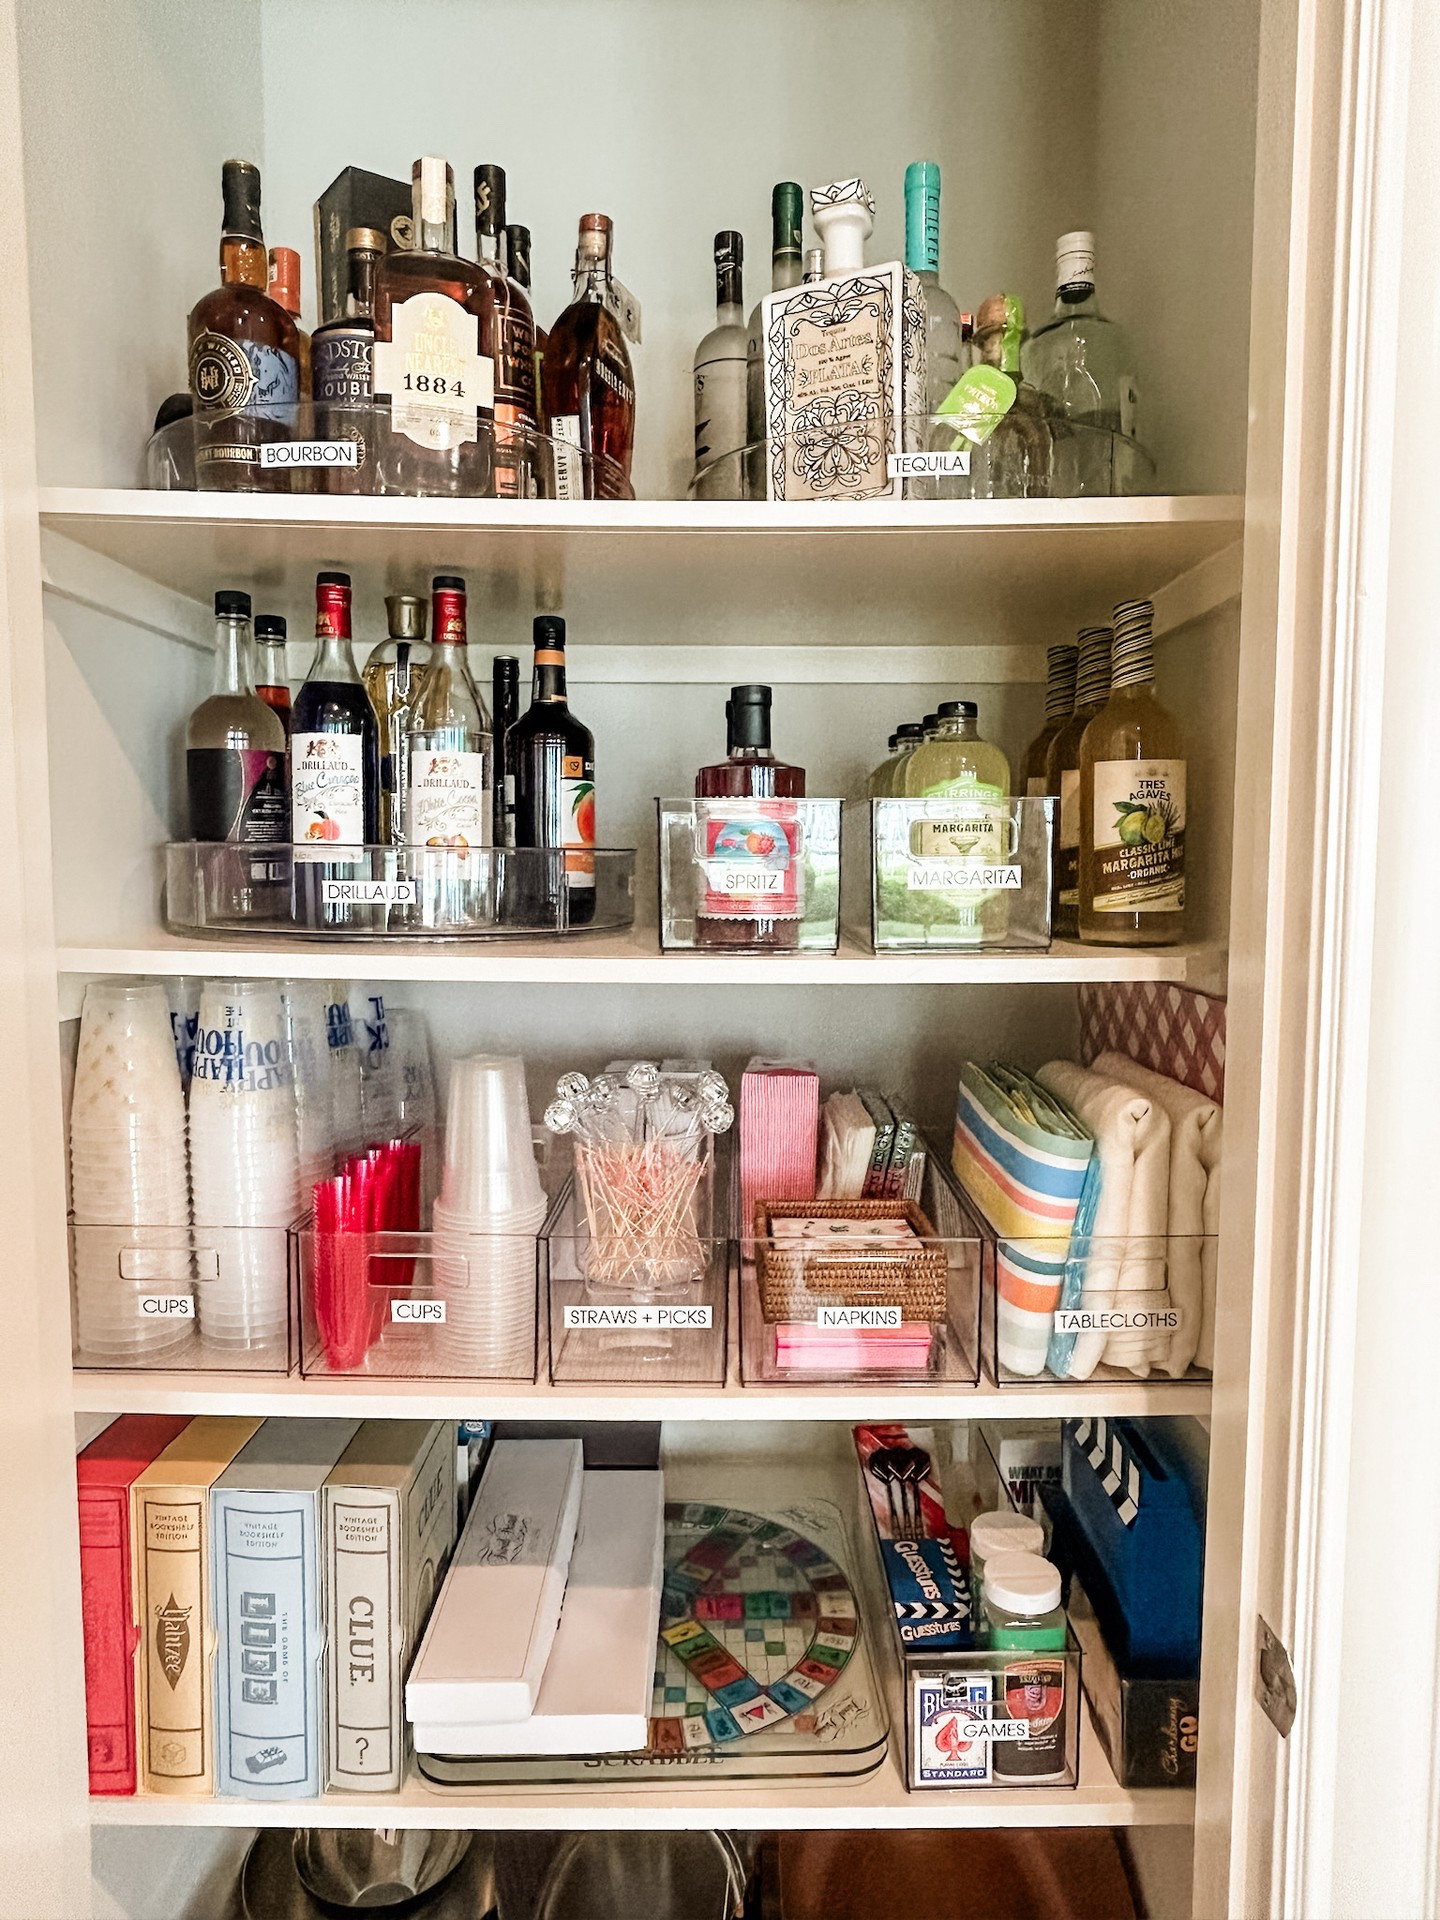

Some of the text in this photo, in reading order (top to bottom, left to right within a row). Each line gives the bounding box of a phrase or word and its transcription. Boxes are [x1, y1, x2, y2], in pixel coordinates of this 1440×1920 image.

[796, 332, 873, 360] Dos Artes
[809, 360, 862, 385] PLATA
[403, 373, 466, 398] 1884
[266, 446, 352, 463] BOURBON
[893, 456, 965, 473] TEQUILA
[302, 760, 348, 771] DRILLAUD
[423, 778, 470, 789] DRILLAUD
[1138, 780, 1165, 790] TRES
[1129, 790, 1172, 801] AGAVES
[932, 823, 994, 833] MARGARITA
[1119, 837, 1175, 858] CLASSIC LIME
[1102, 851, 1169, 875] MARGARITA
[725, 874, 778, 889] SPRITZ
[912, 869, 1018, 885] MARGARITA
[328, 884, 411, 900] DRILLAUD
[143, 1299, 189, 1314] CUPS
[397, 1304, 442, 1319] CUPS
[570, 1309, 707, 1325] STRAWS + PICKS
[824, 1310, 898, 1326] NAPKINS
[1060, 1312, 1178, 1329] TABLECLOTHS
[150, 1523, 194, 1532] BOOKSHELF
[239, 1530, 285, 1539] BOOKSHELF
[339, 1524, 384, 1534] BOOKSHELF
[156, 1533, 188, 1541] EDITION
[246, 1540, 278, 1548] EDITION
[155, 1604, 192, 1673] Yahtzee
[348, 1595, 374, 1686] CLUE
[244, 1594, 274, 1701] LIFE
[963, 1722, 1026, 1738] GAMES
[922, 1769, 985, 1778] STANDARD
